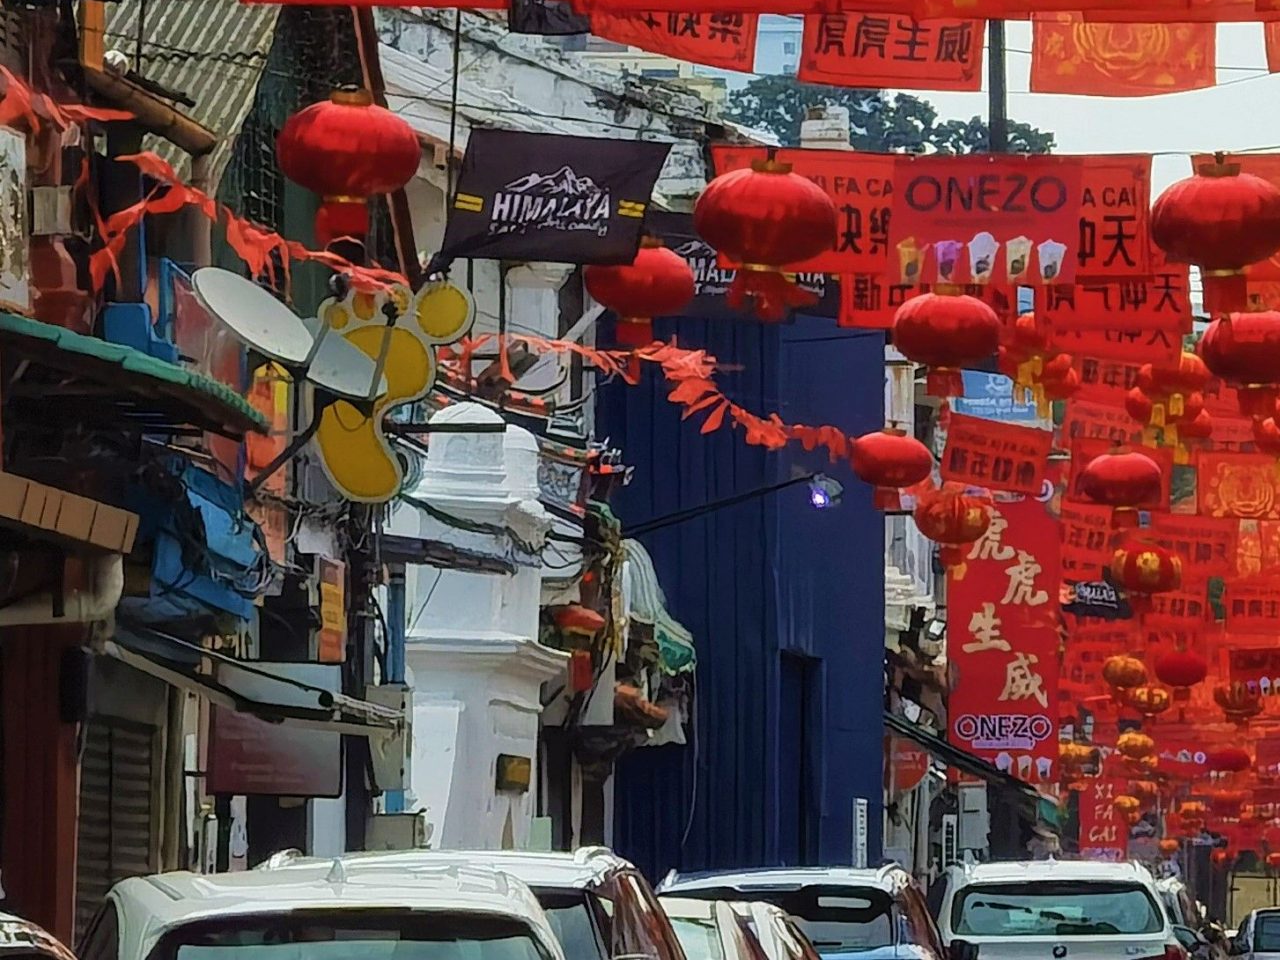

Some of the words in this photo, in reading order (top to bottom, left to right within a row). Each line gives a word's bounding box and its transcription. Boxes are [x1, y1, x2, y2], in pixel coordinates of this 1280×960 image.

[833, 175, 861, 195] FA
[904, 173, 1069, 213] ONEZO
[1102, 185, 1136, 208] CAI
[955, 715, 1051, 739] ONEZO
[1095, 783, 1113, 799] XI
[1094, 804, 1113, 820] FA
